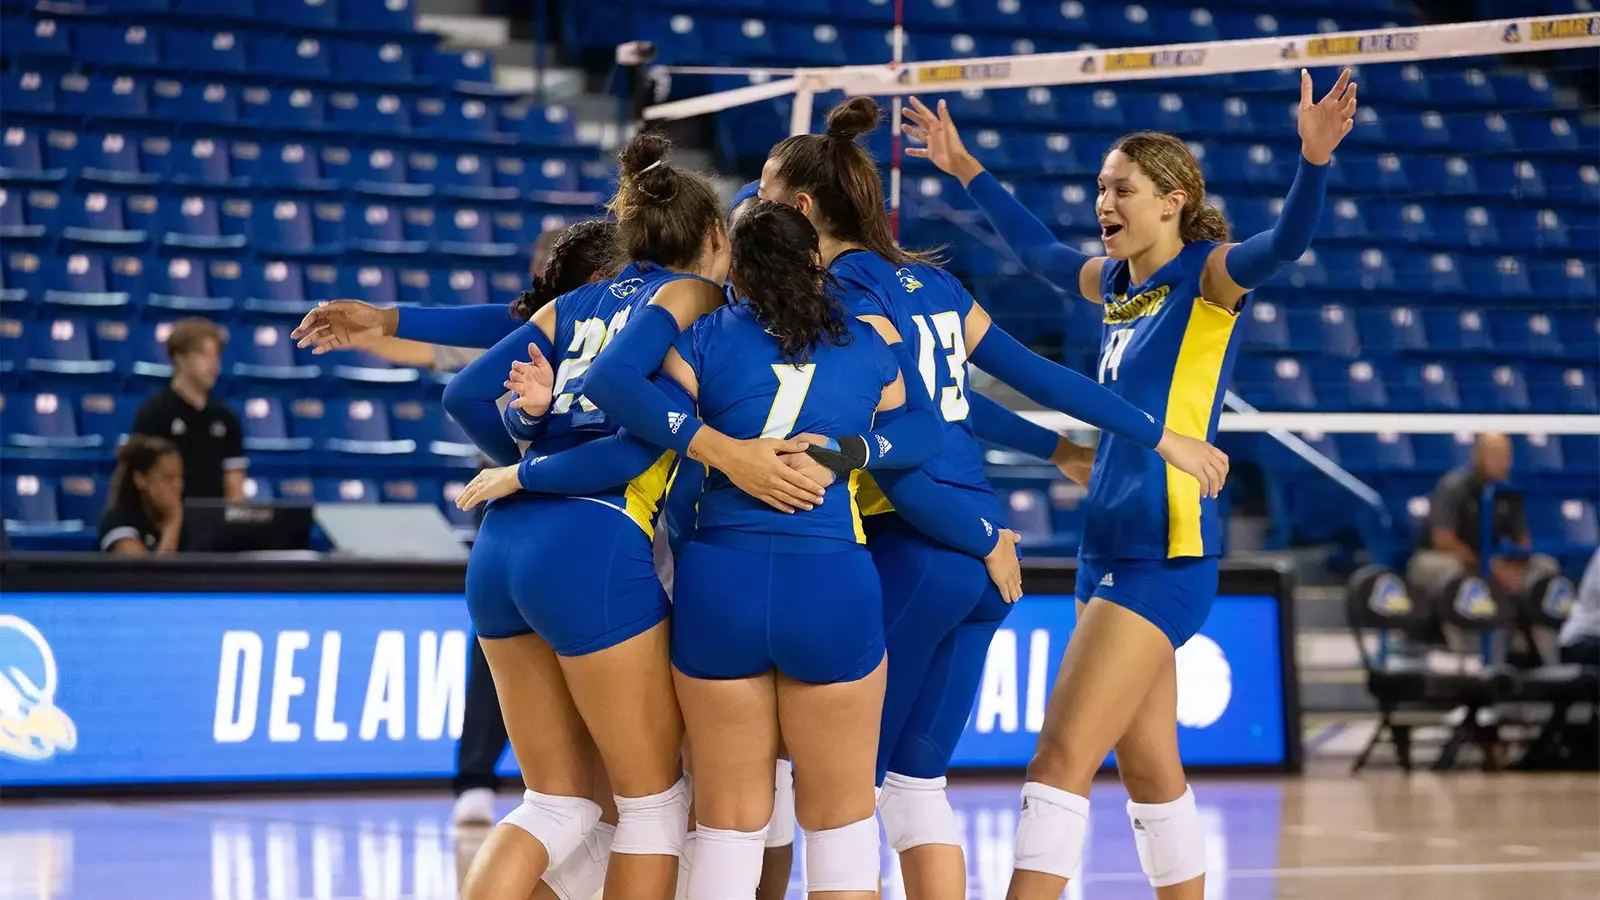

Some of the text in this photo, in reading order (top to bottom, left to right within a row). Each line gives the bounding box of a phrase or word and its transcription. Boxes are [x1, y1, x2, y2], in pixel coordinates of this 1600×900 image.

[759, 363, 817, 441] 1
[911, 310, 970, 422] 13
[213, 630, 467, 743] DELAW
